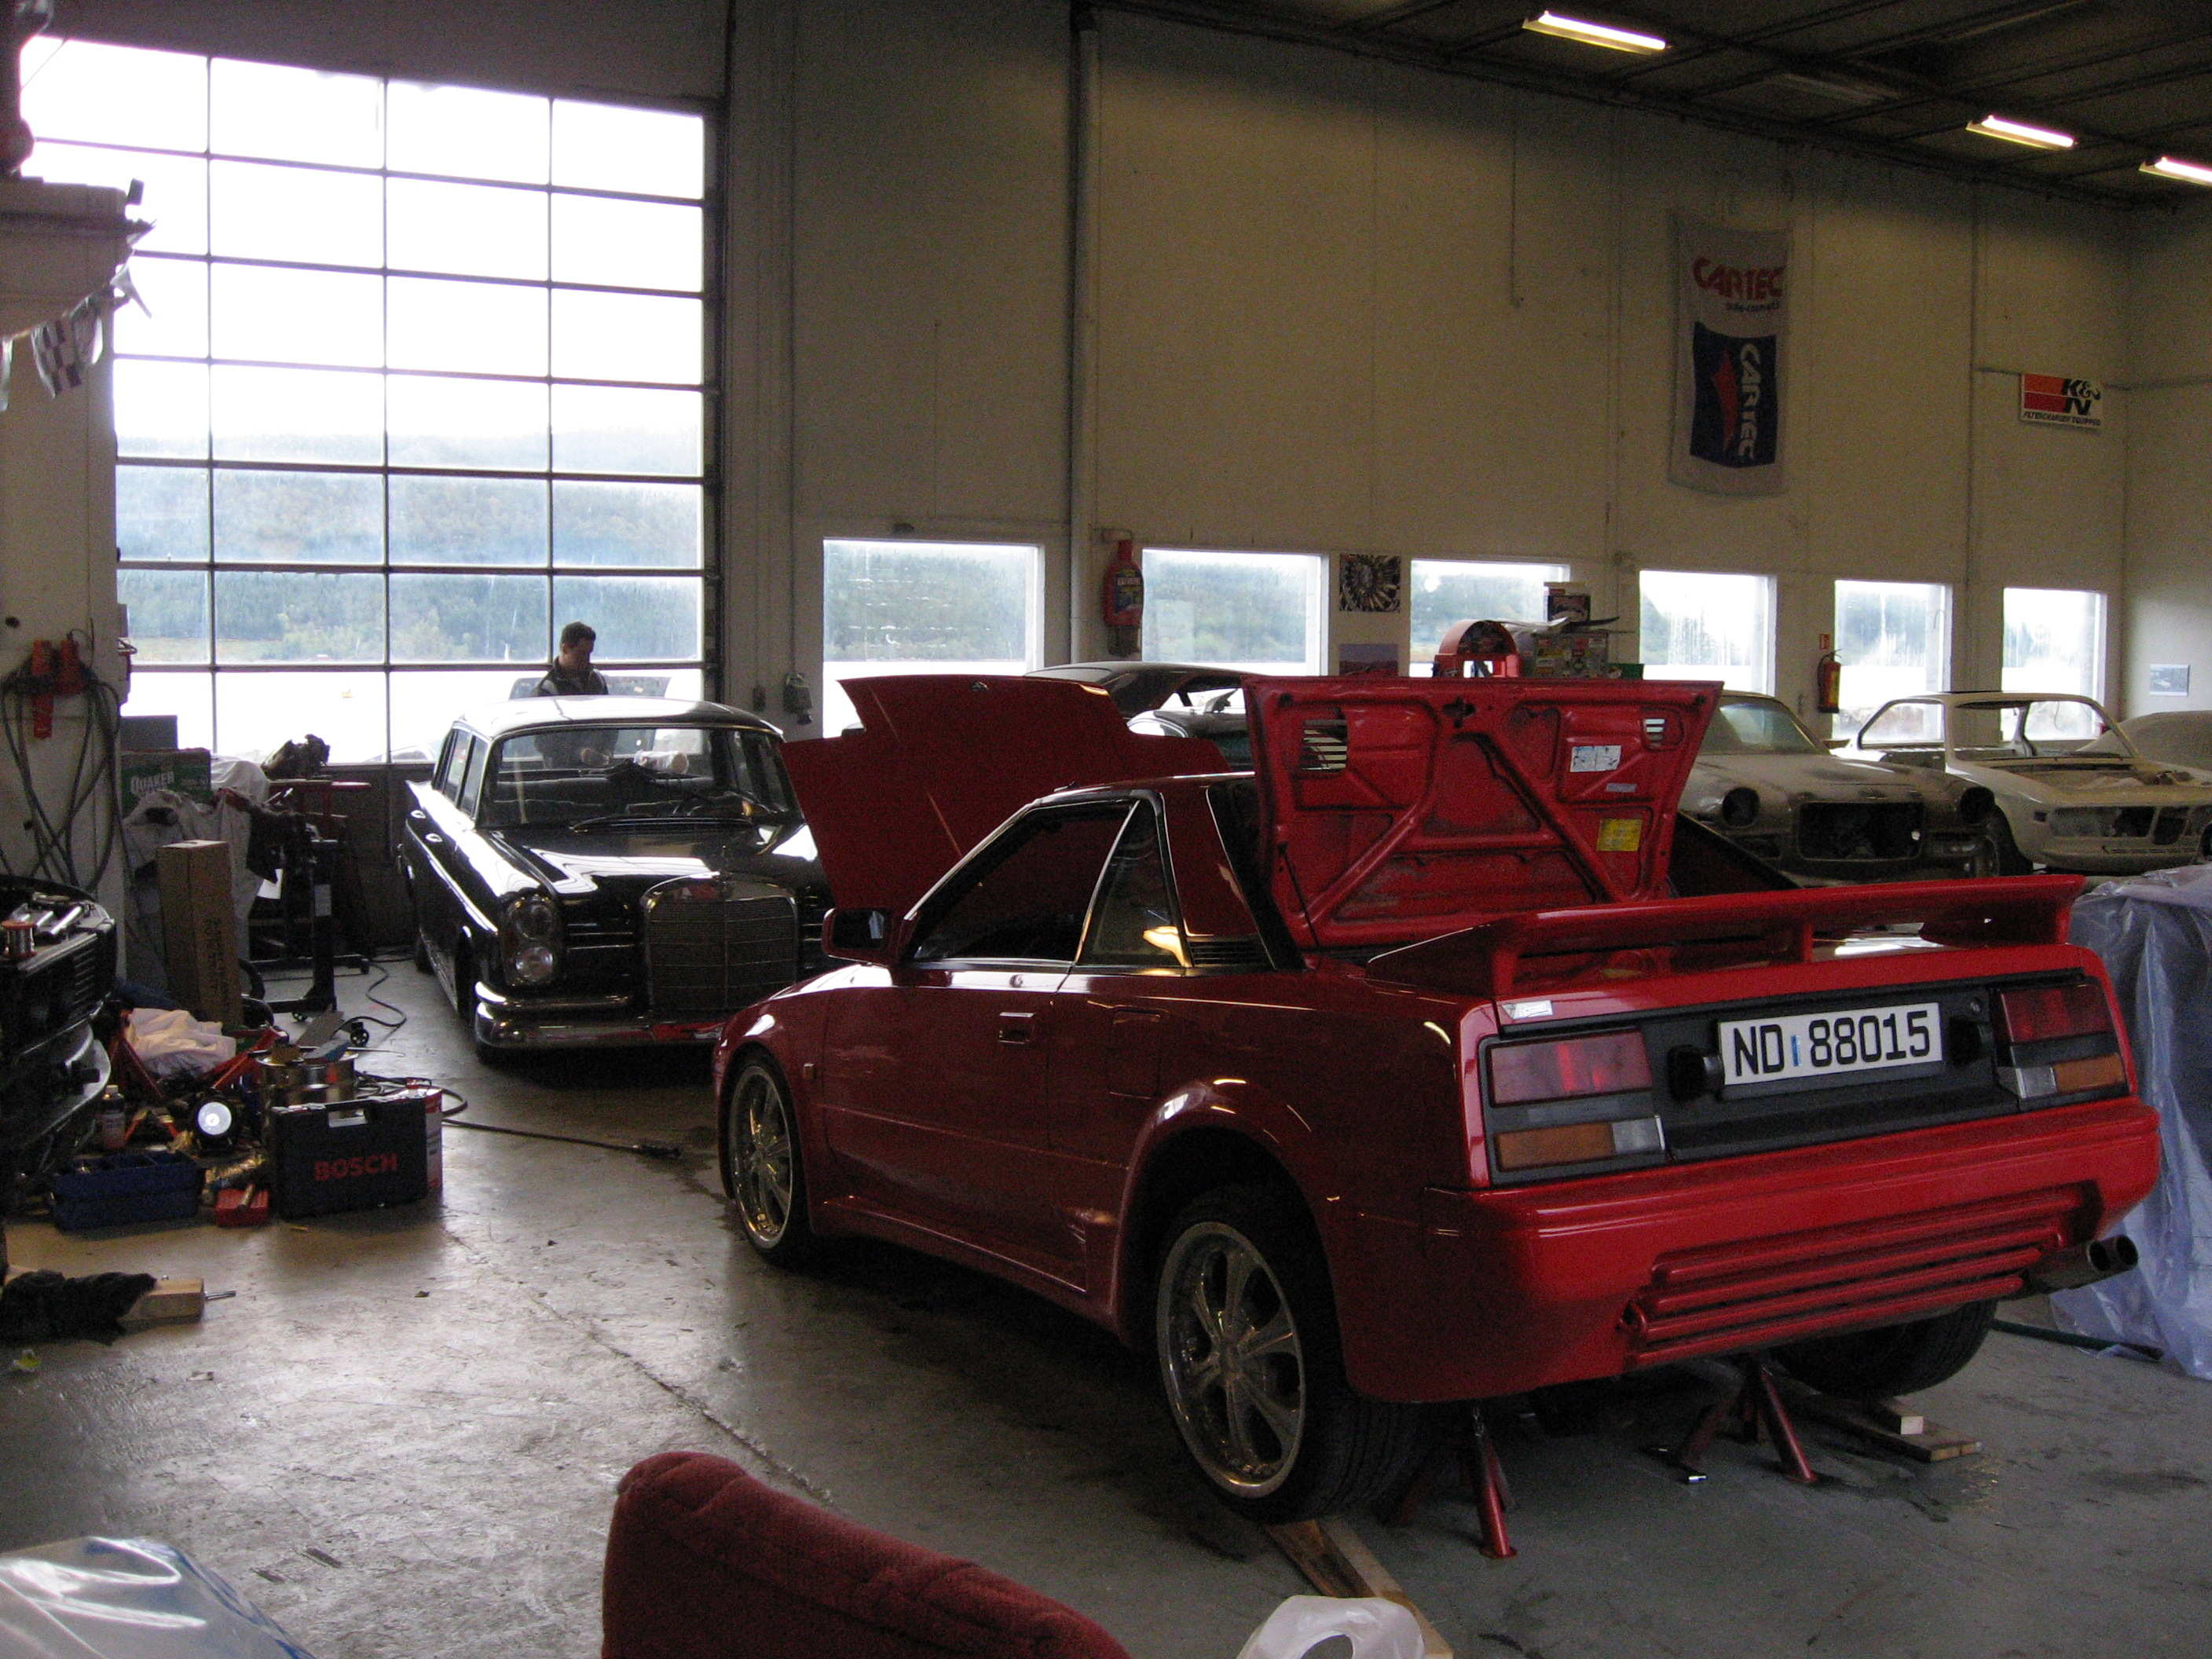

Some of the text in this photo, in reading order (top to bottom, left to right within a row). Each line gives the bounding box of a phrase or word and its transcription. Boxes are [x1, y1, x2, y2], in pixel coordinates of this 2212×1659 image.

[1693, 256, 1786, 301] CARTEC
[1738, 342, 1762, 461] CARTEC
[1733, 1010, 1930, 1077] ND 88015
[314, 1152, 401, 1181] BOSCH
